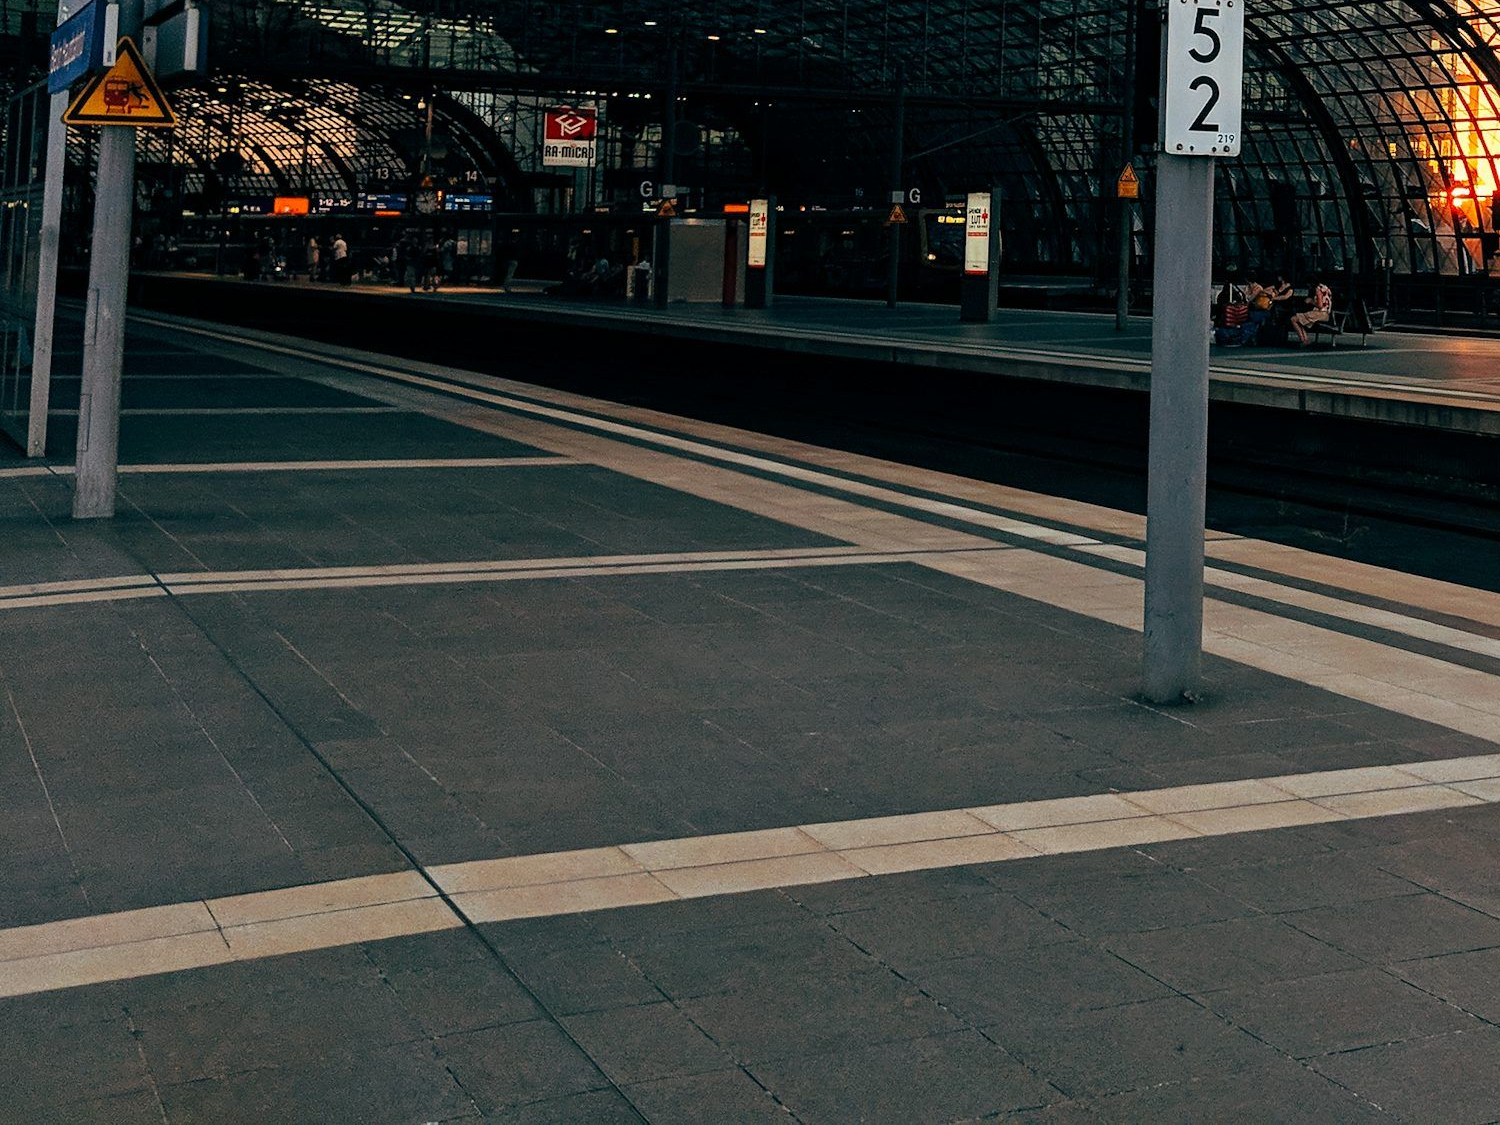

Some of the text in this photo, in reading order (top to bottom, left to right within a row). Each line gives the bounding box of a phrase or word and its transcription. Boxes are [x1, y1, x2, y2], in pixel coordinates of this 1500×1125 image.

[1188, 7, 1221, 64] 5
[1188, 75, 1220, 133] 2
[1216, 133, 1235, 144] 219
[375, 168, 389, 179] 13
[464, 171, 477, 181] 14
[640, 180, 653, 197] G
[909, 187, 921, 204] G
